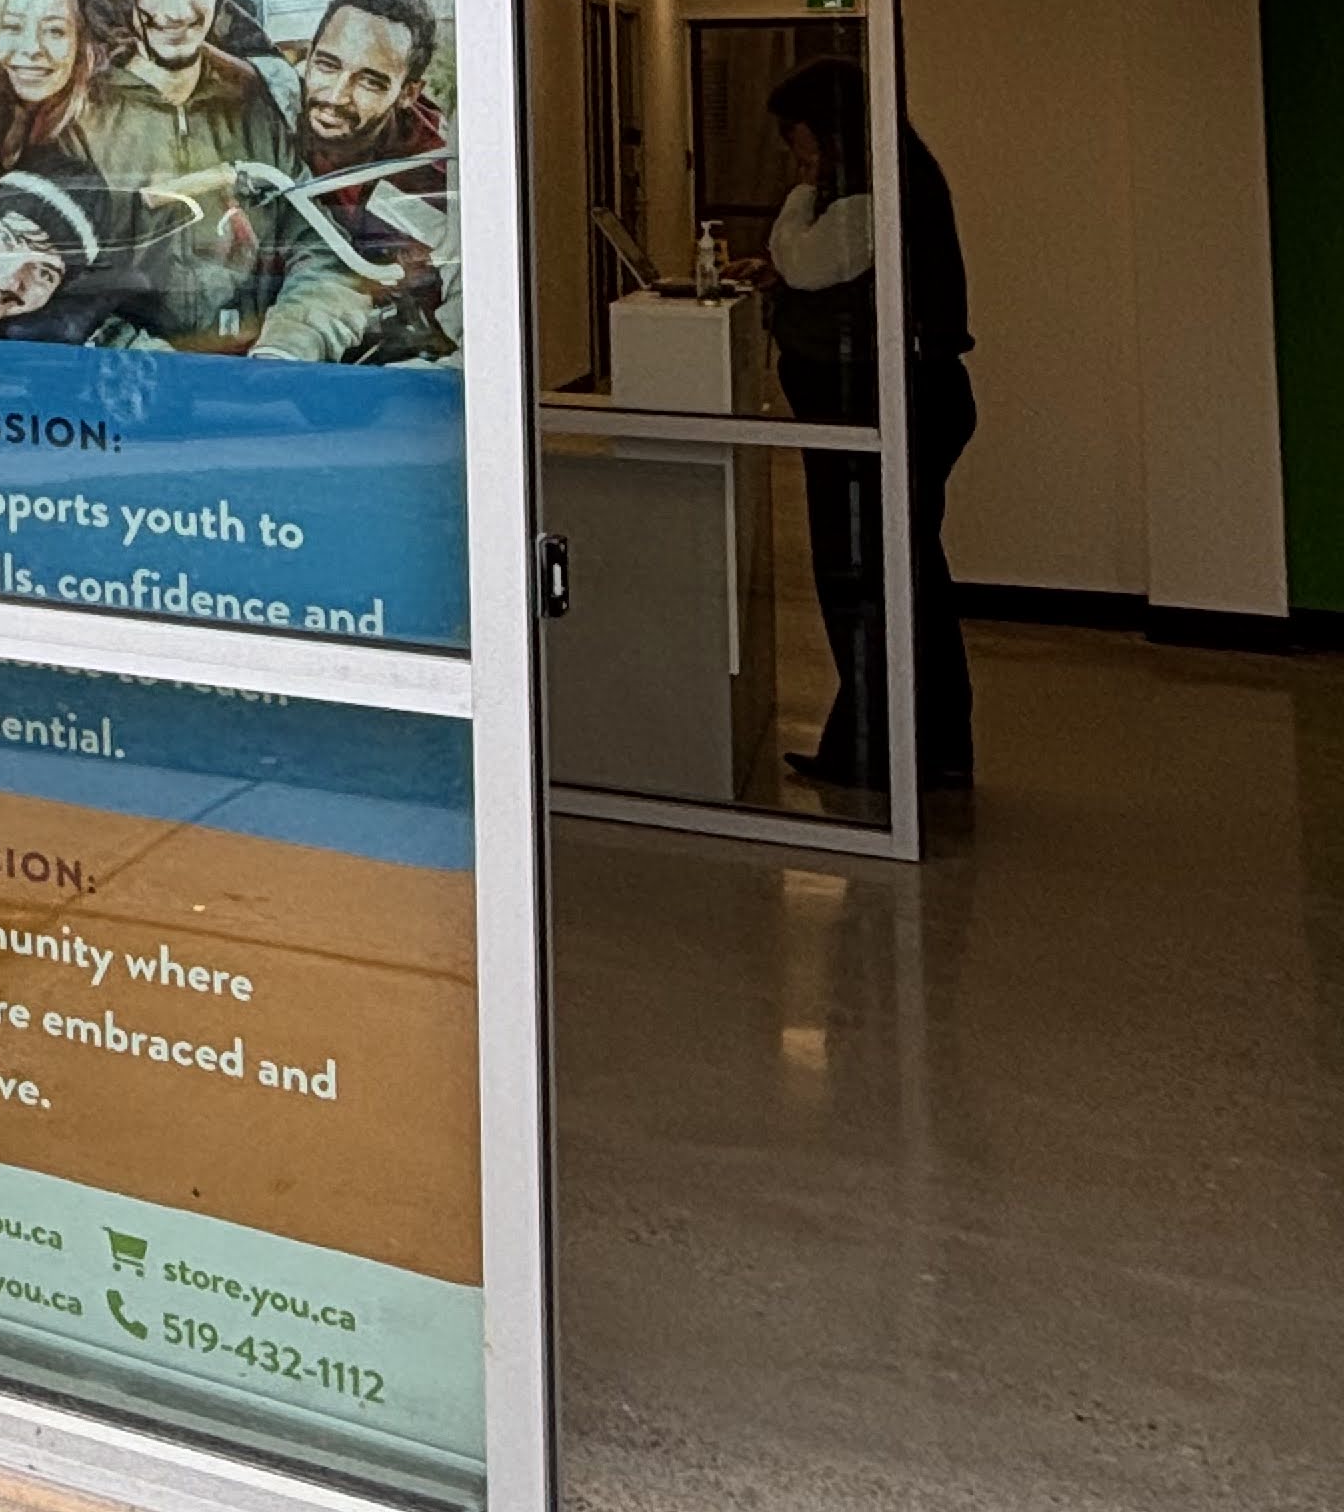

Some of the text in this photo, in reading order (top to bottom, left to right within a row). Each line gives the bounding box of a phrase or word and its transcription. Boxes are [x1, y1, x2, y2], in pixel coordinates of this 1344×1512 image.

[121, 500, 246, 547] youth
[260, 514, 304, 550] to
[58, 568, 290, 626] confidence
[303, 600, 384, 637] and
[126, 945, 253, 1002] where
[42, 1008, 244, 1079] embraced
[258, 1058, 338, 1100] and
[163, 1260, 357, 1332] store.you.ca
[162, 1313, 386, 1404] 519-432-1112
